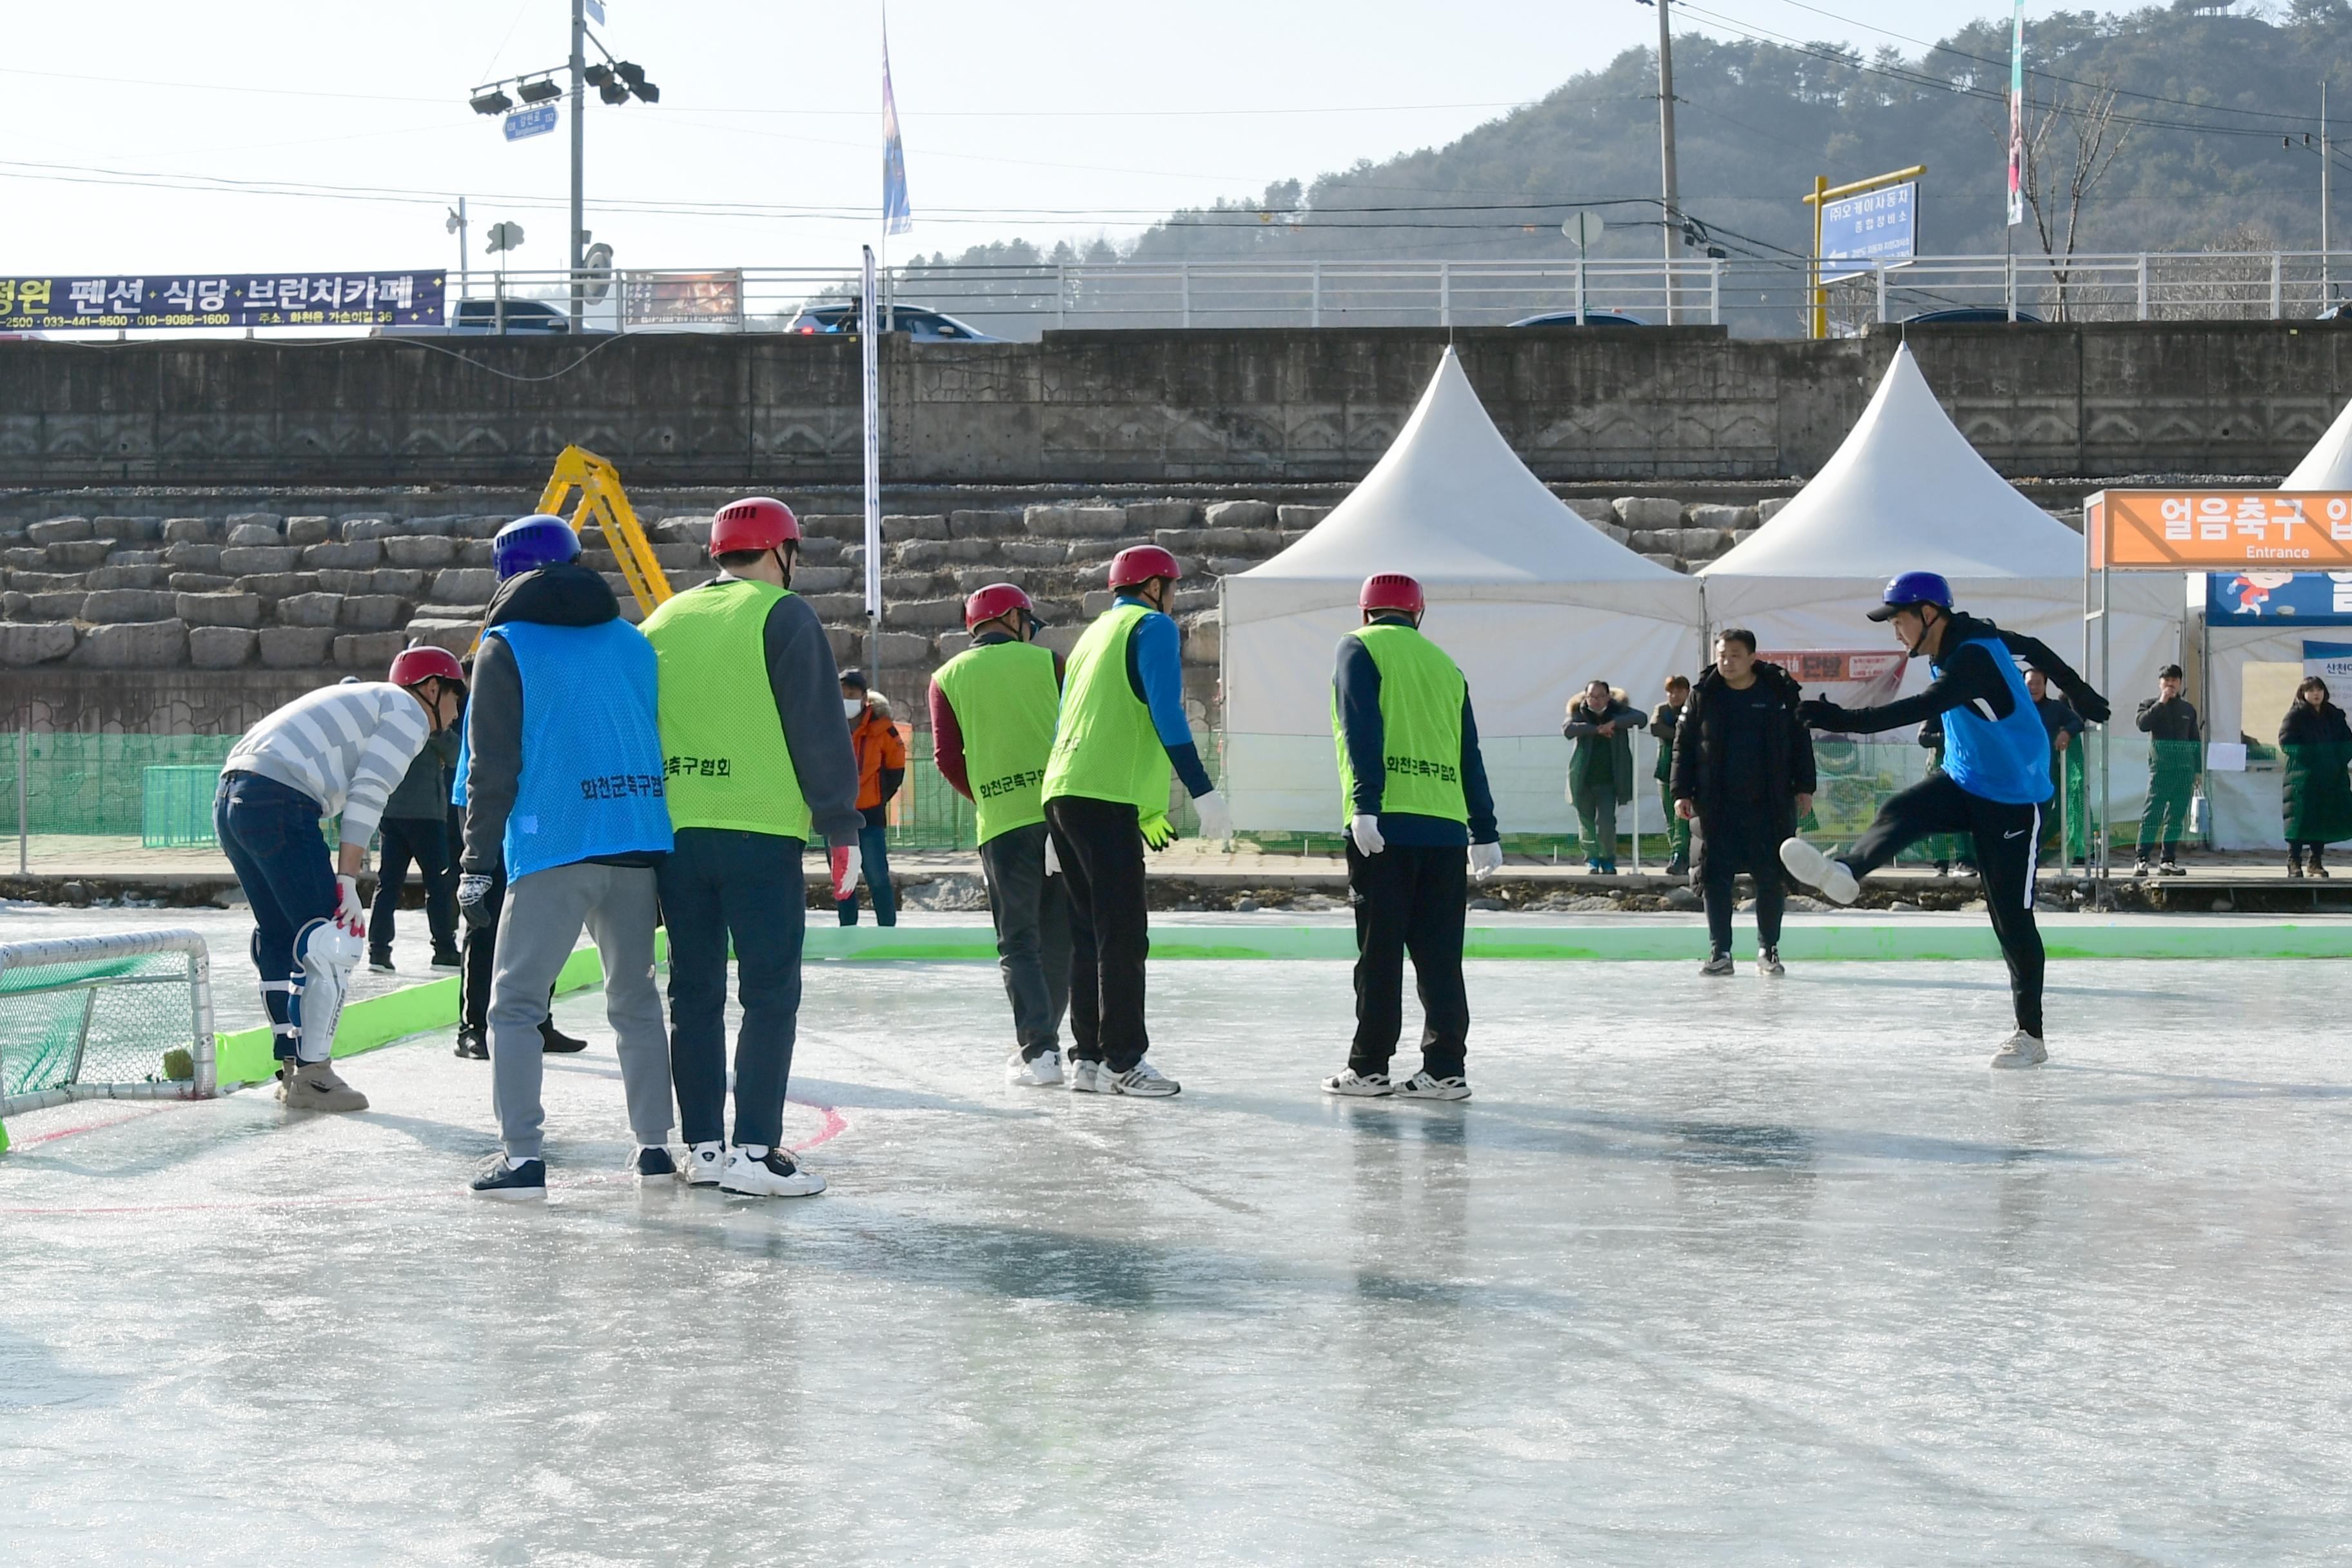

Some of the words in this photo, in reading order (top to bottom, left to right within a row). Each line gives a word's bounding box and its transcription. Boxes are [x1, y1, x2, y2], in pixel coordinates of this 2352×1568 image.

[69, 279, 144, 315] 펜션
[163, 279, 230, 312] 식당
[243, 275, 413, 310] 브런치카페
[377, 311, 392, 322] 36
[2161, 497, 2306, 541] 얼음축구
[2246, 545, 2310, 559] Entrance
[663, 756, 730, 782] 축구협회
